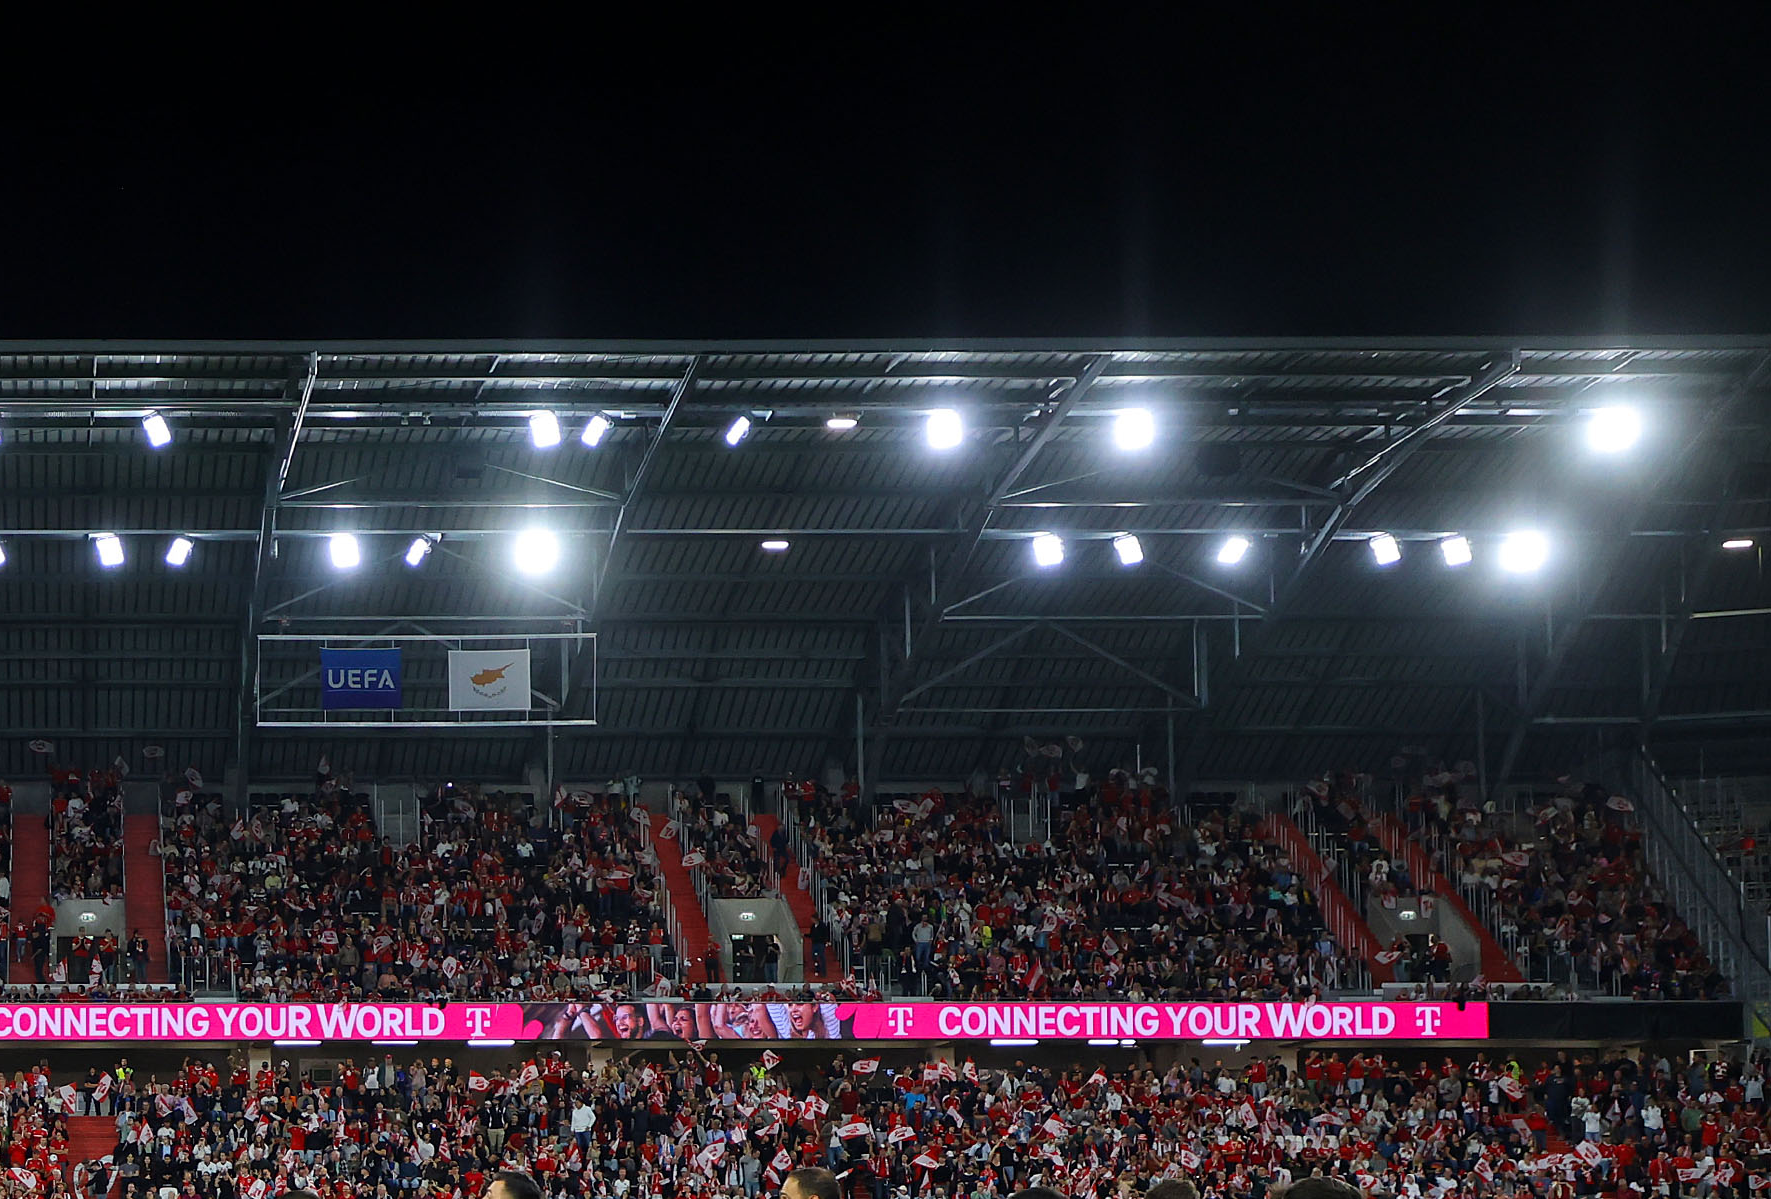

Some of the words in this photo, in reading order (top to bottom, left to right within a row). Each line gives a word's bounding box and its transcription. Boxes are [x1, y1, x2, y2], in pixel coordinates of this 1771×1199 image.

[328, 669, 396, 689] UEFA
[217, 1006, 312, 1037] YOUR
[315, 1004, 445, 1038] WORLD
[466, 1008, 491, 1036] T
[888, 1007, 913, 1035] T
[938, 1006, 1160, 1036] CONNECTING
[1165, 1006, 1261, 1036] YOUR
[1265, 1003, 1396, 1037] WORLD
[1415, 1007, 1441, 1036] T
